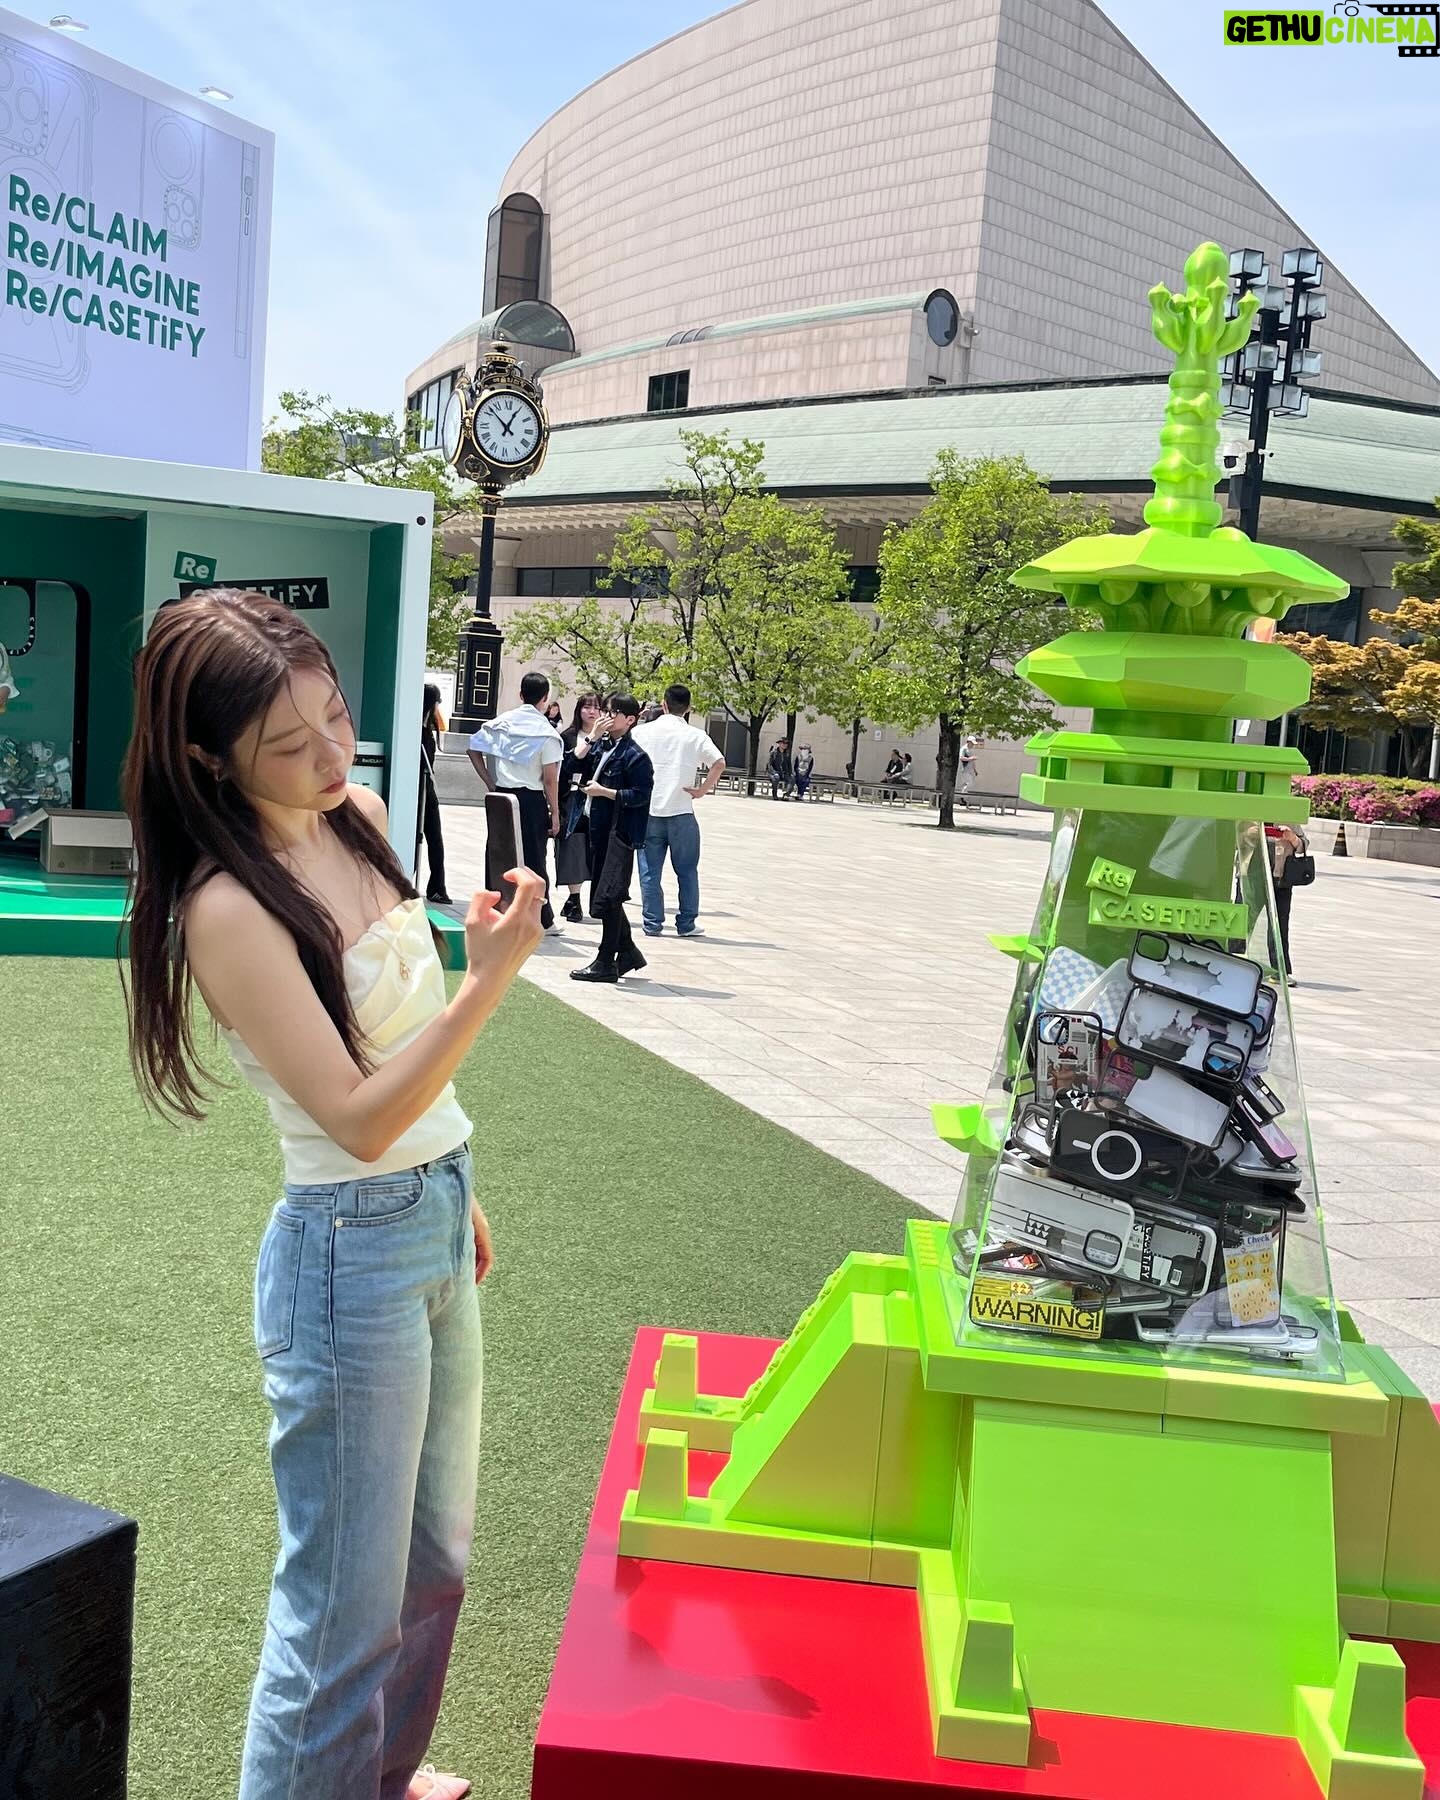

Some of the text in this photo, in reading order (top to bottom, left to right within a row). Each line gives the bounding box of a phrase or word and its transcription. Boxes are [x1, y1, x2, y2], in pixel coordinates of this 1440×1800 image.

[9, 174, 168, 263] Re/CLAIM
[7, 221, 201, 317] Re/IMAGINE
[6, 268, 206, 358] Re/CASETiFY
[180, 556, 210, 579] Re
[1098, 862, 1128, 888] Re
[1101, 899, 1239, 931] CASETiFY
[974, 1295, 1100, 1331] WARNING!
